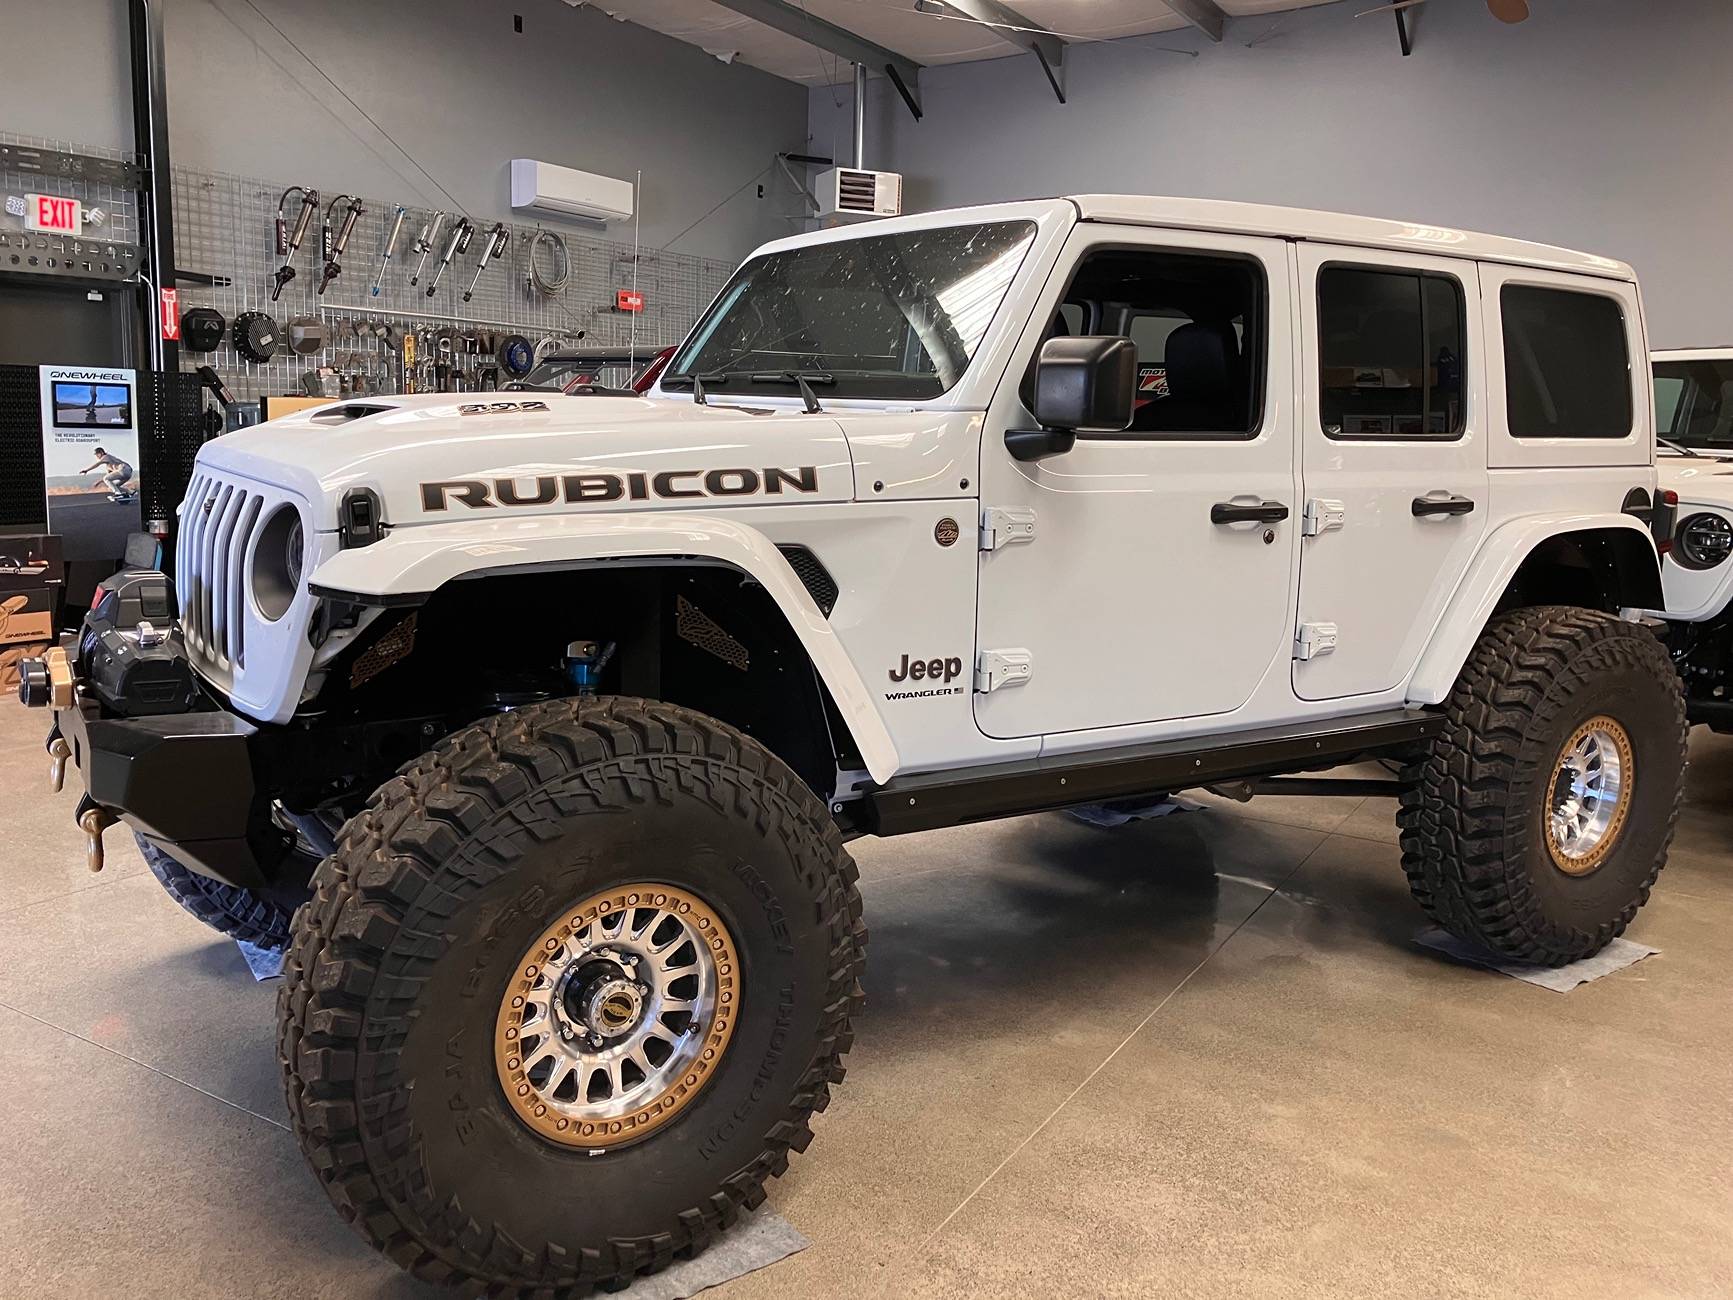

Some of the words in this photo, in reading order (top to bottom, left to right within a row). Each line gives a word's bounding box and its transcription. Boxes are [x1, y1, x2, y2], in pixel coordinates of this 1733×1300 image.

[39, 197, 75, 229] EXIT
[50, 371, 128, 381] ONEWHEEL
[459, 401, 551, 416] 392
[419, 466, 819, 513] RUBICON
[888, 654, 962, 683] Jeep
[885, 688, 952, 701] WRANGLER
[699, 982, 795, 1161] THOMPSON
